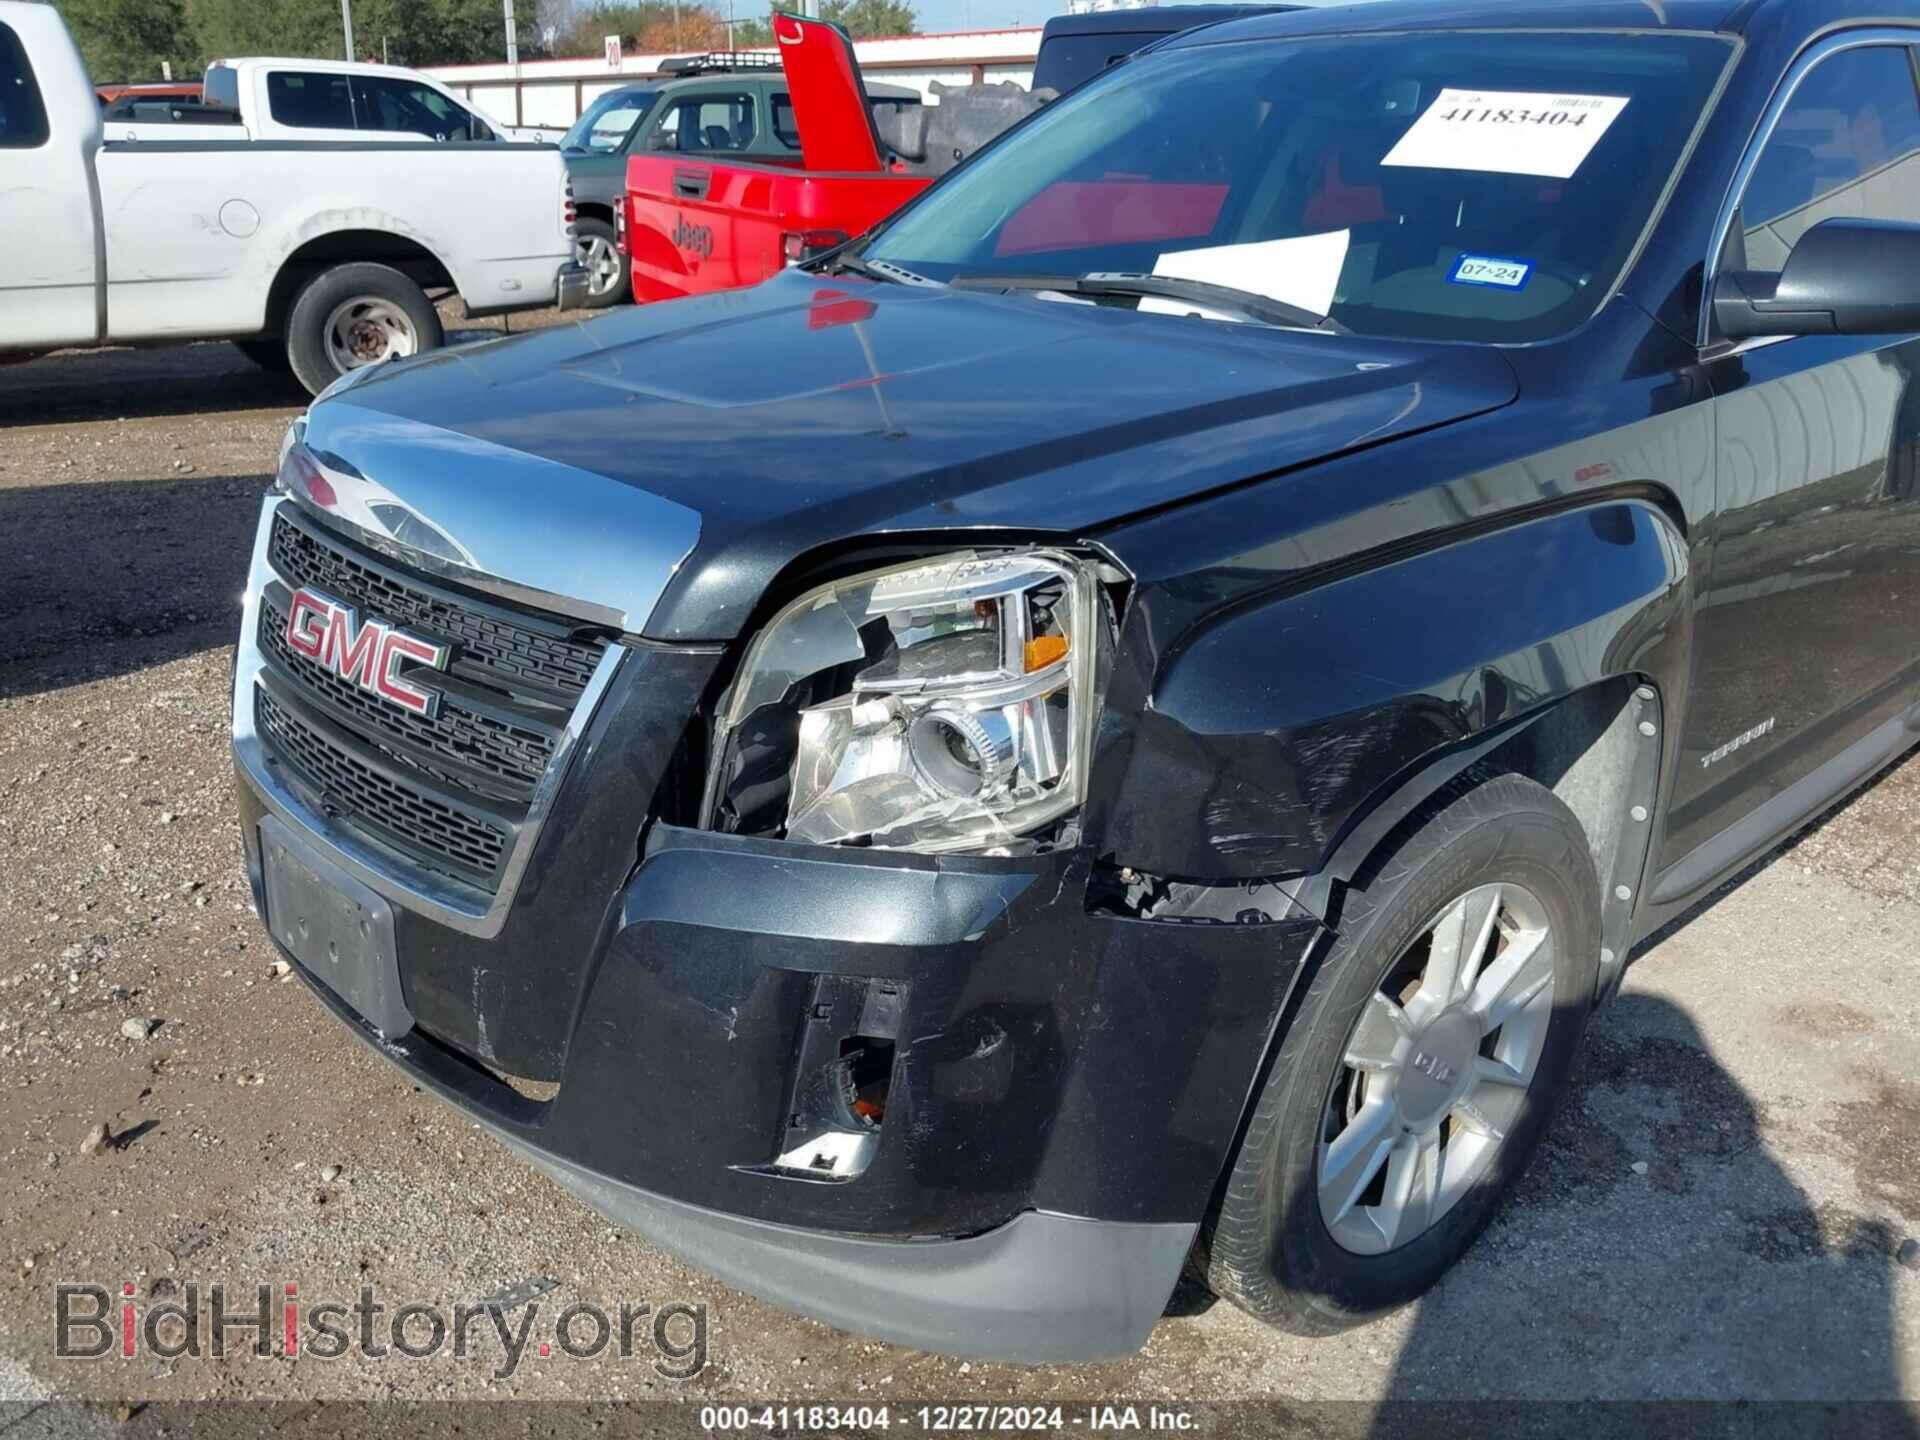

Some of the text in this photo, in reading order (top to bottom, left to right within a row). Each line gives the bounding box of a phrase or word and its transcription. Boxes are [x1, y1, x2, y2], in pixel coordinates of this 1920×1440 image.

[1440, 108, 1588, 127] 41183404
[672, 210, 713, 259] Jeep
[287, 583, 450, 720] GMC
